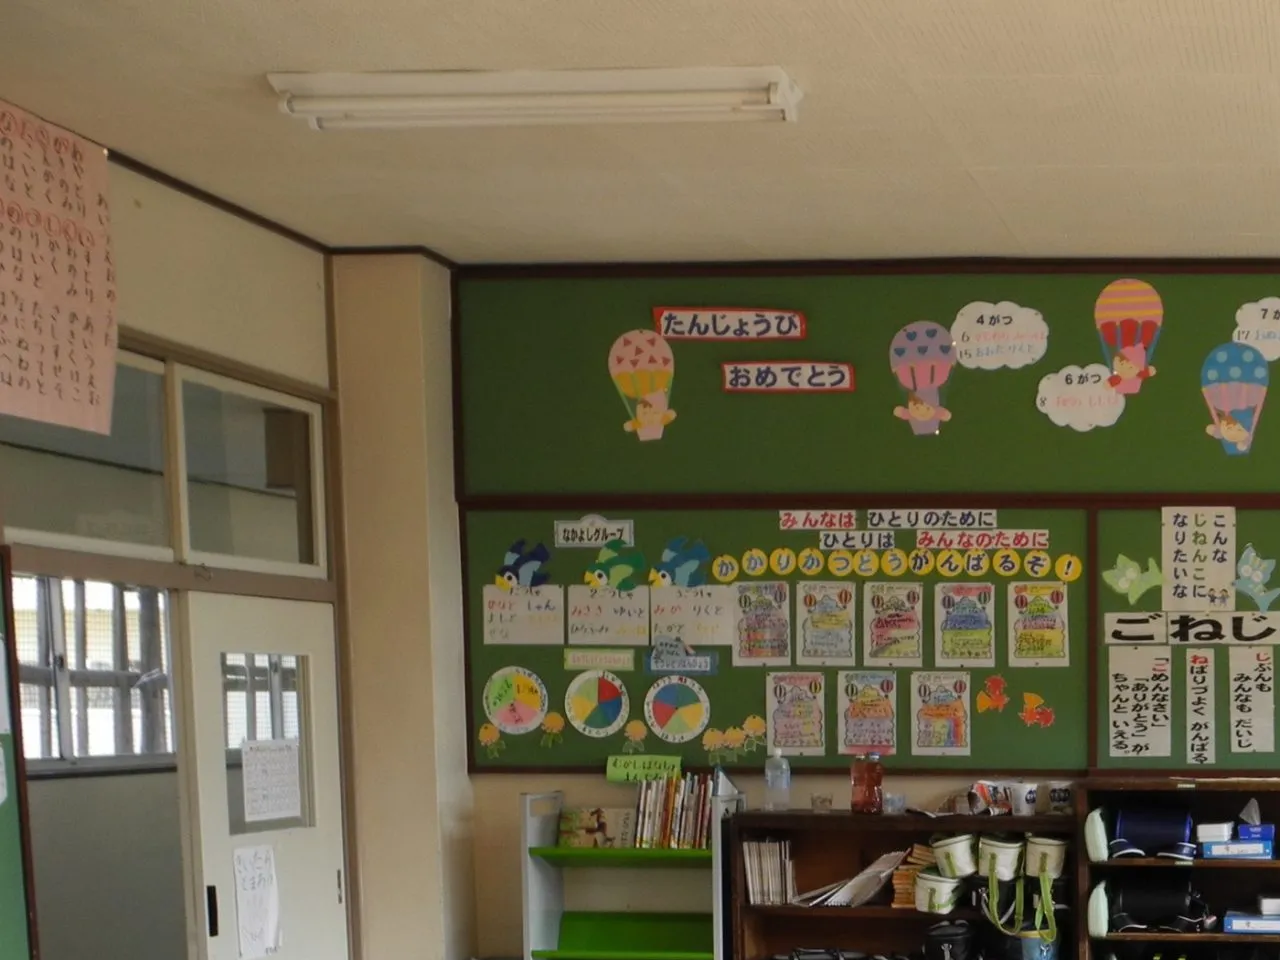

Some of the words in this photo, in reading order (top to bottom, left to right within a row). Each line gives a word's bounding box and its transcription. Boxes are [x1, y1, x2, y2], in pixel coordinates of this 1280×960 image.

[663, 310, 801, 337] たんじょうび
[728, 364, 848, 388] おめでとう
[781, 512, 855, 527] みんなは
[869, 511, 994, 526] ひとりのために
[1212, 514, 1228, 564] こんな
[823, 532, 894, 548] ひとりは
[917, 532, 1048, 548] みんなのために
[1173, 513, 1189, 599] なりたいな
[1192, 513, 1208, 598] じねんこに
[1111, 613, 1277, 642] ごねじ
[1190, 654, 1209, 717] ねばりづよく
[1253, 652, 1273, 693] じぶんも
[1232, 673, 1253, 713] みんなも
[1190, 721, 1210, 764] がんばる
[1235, 718, 1254, 749] だいじ
